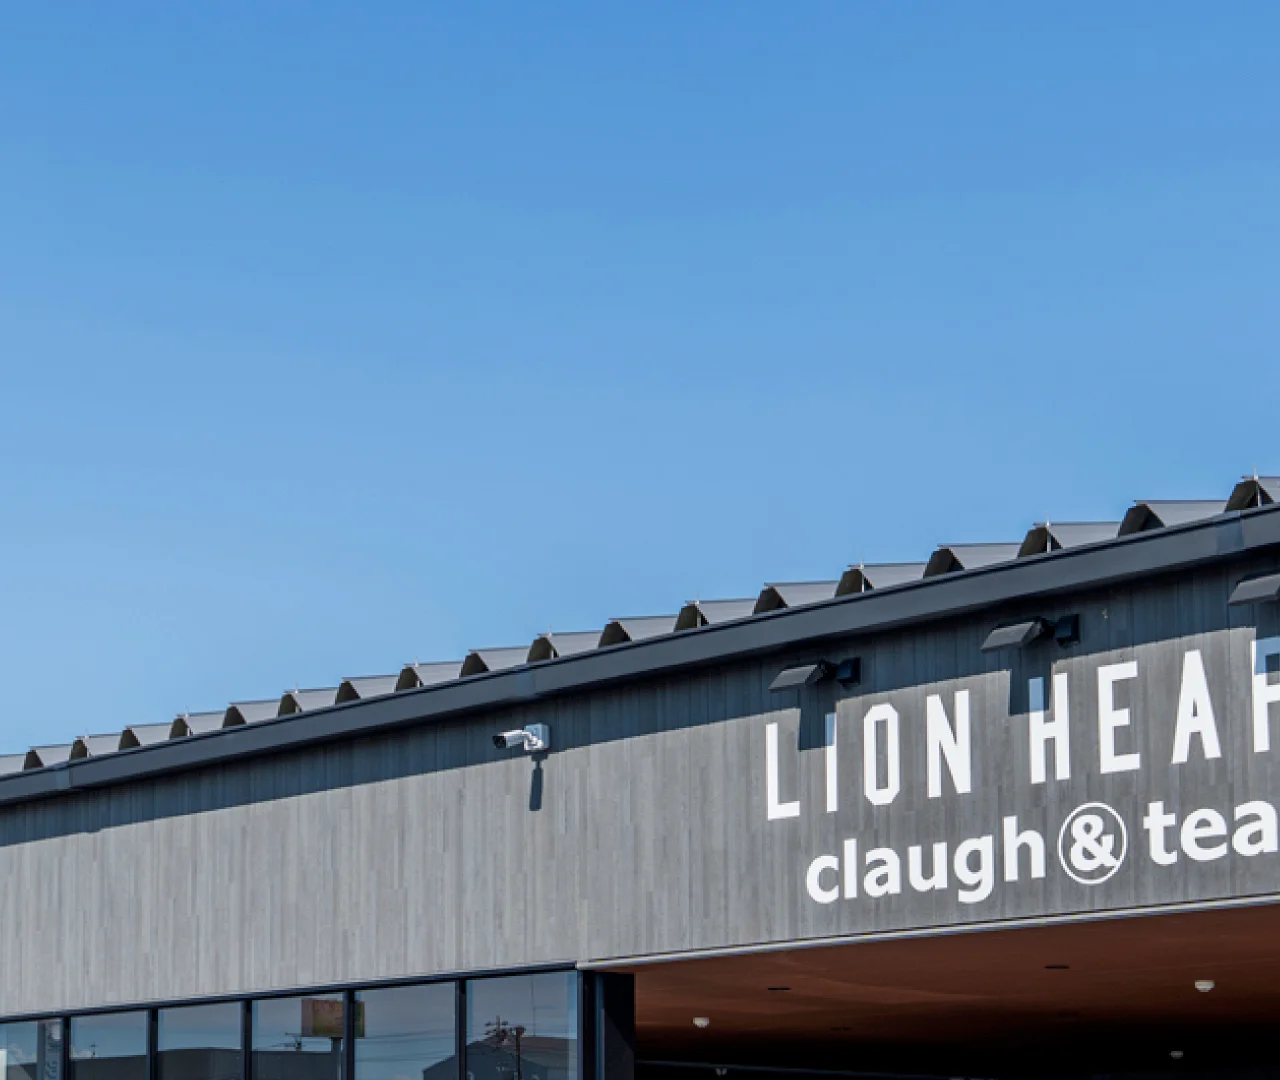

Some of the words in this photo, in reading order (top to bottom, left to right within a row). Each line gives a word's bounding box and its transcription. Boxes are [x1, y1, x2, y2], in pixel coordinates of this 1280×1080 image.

[765, 690, 972, 821] LION
[805, 815, 1046, 905] claugh
[1061, 805, 1124, 882] &
